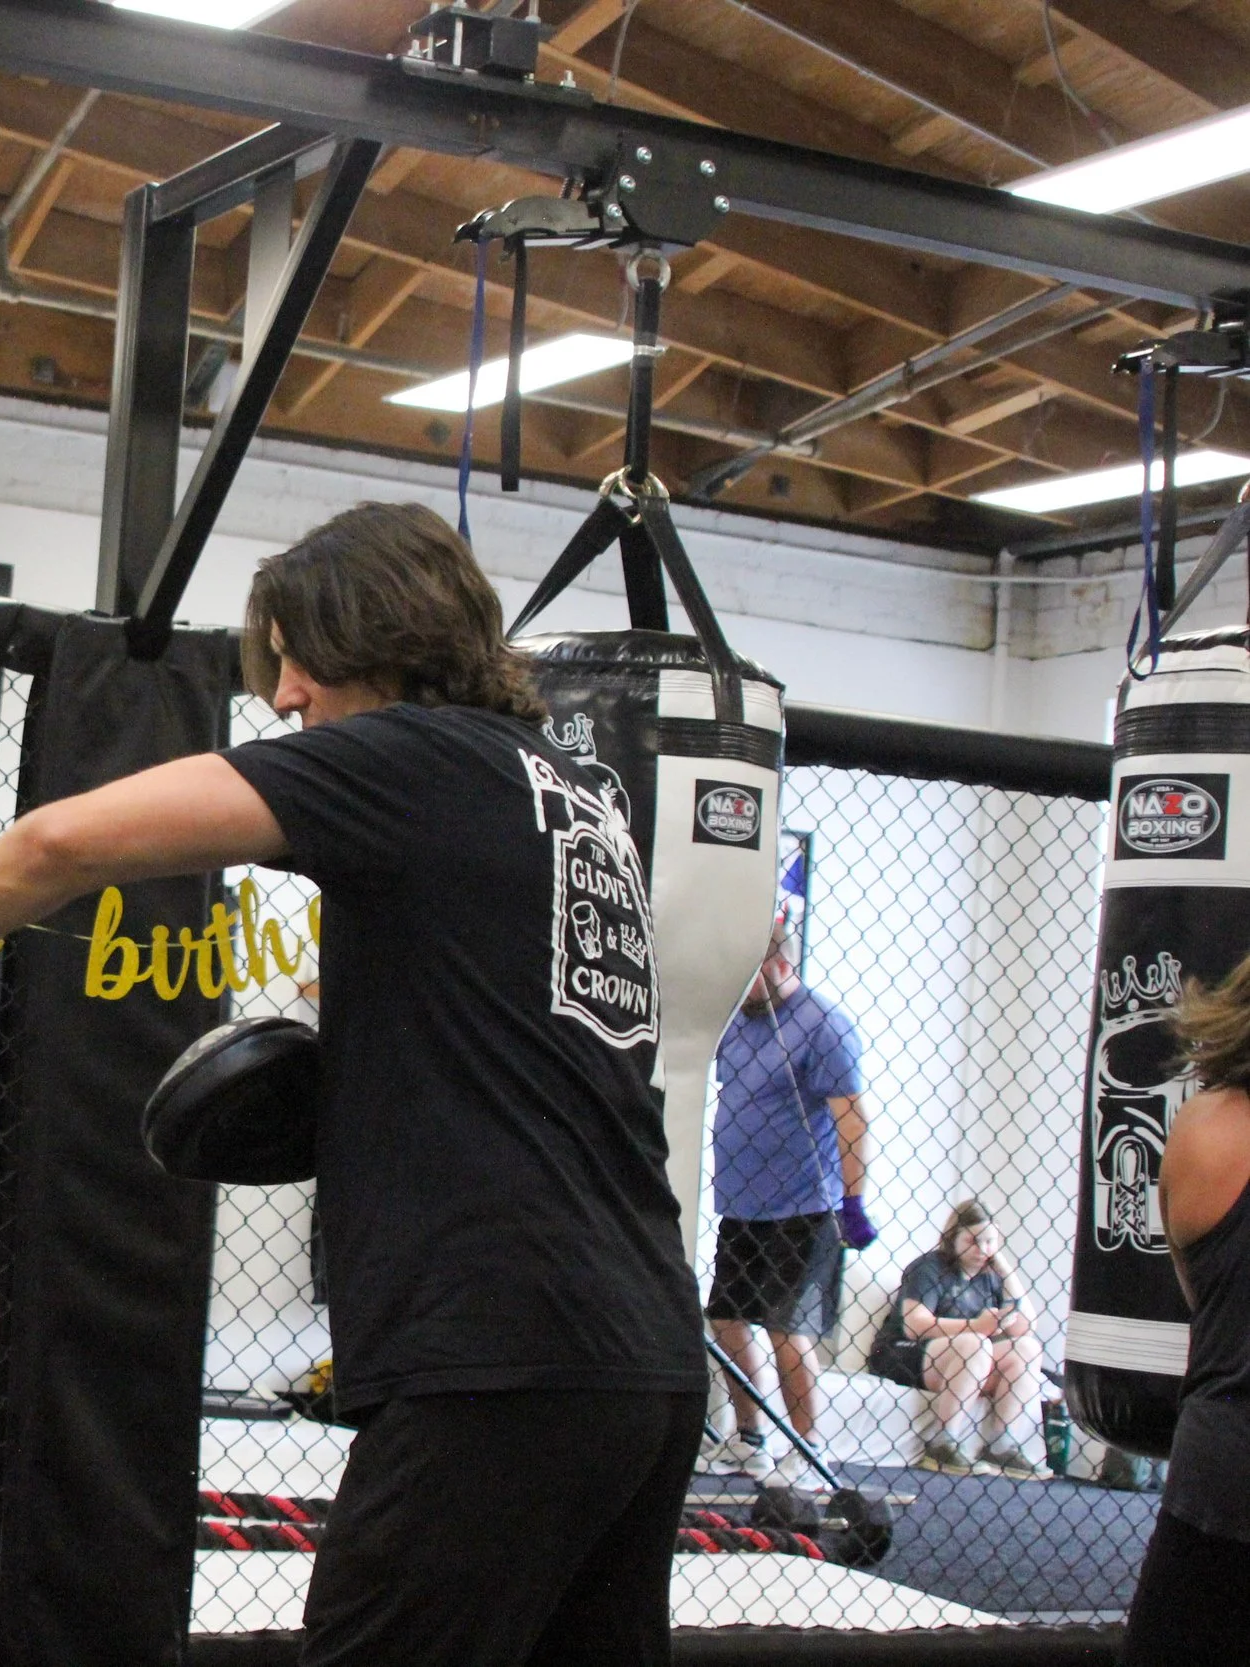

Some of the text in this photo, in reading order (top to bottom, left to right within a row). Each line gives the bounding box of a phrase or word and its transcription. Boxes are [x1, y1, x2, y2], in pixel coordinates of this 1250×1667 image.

[708, 795, 755, 817] NAZO
[1129, 793, 1207, 817] NAZO
[708, 815, 753, 831] BOXING
[1128, 819, 1201, 836] BOXING
[590, 843, 607, 866] THE
[571, 857, 633, 910] GLOVE
[606, 926, 618, 951] &
[572, 965, 649, 1016] CROWN
